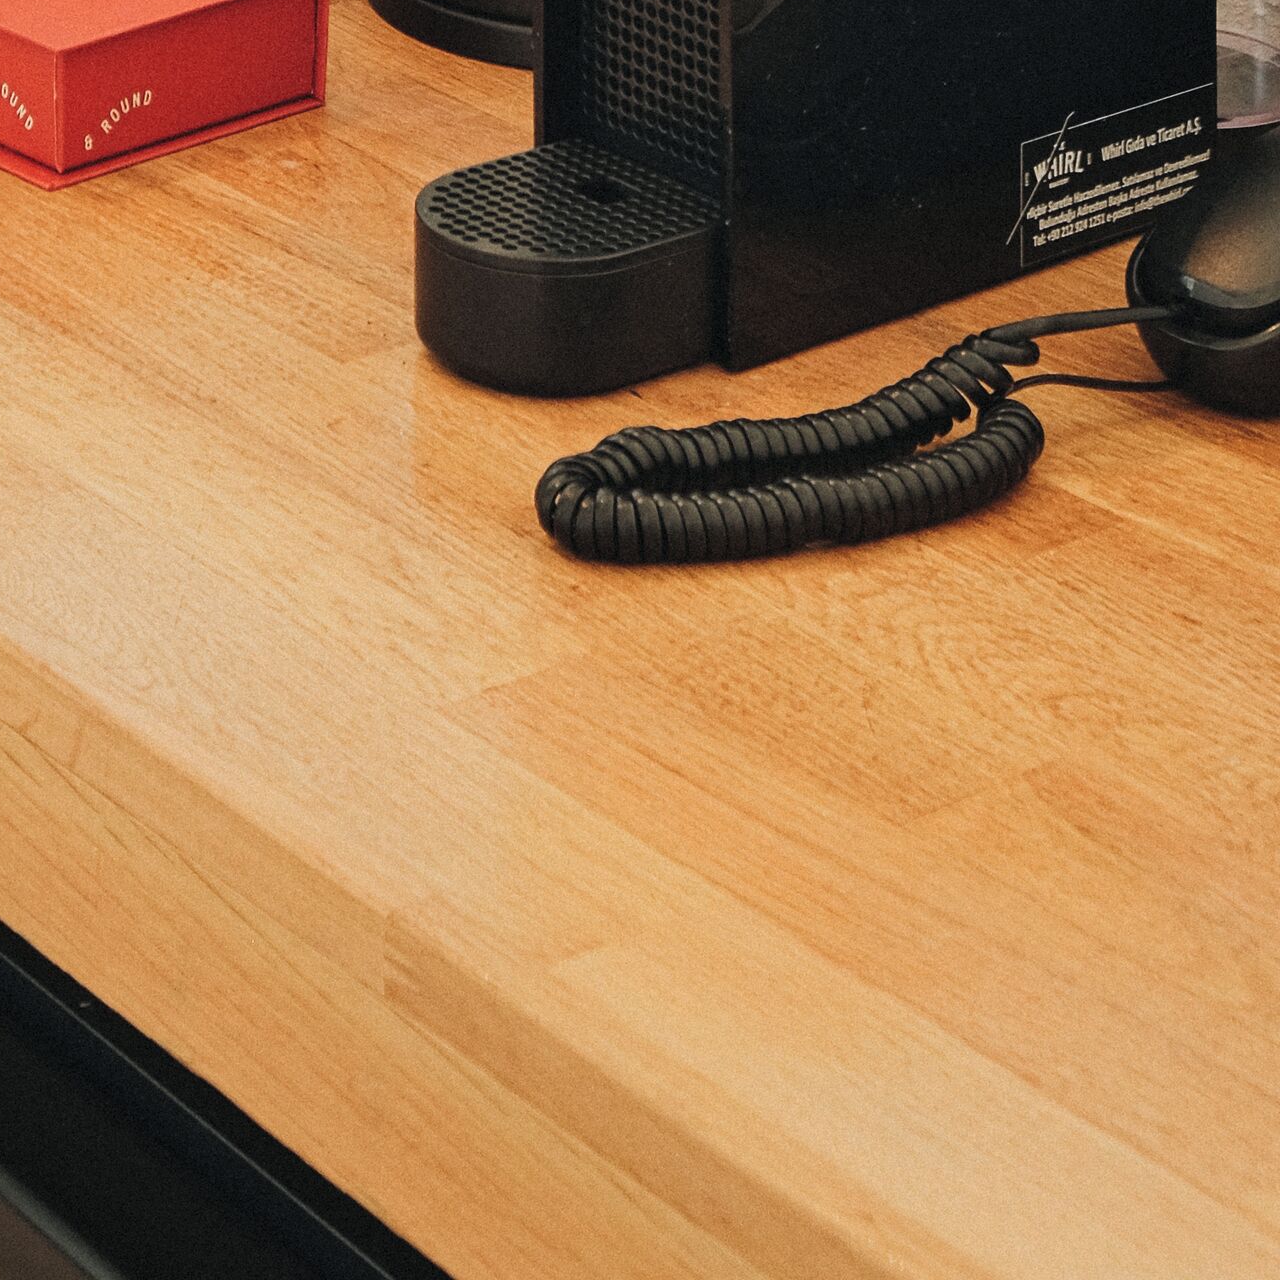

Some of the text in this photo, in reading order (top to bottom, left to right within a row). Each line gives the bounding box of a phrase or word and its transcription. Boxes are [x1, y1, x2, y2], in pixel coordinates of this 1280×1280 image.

[101, 89, 152, 134] ROUND
[1101, 140, 1125, 161] Whirl
[1146, 133, 1157, 147] ve
[1157, 124, 1186, 144] Ticaret
